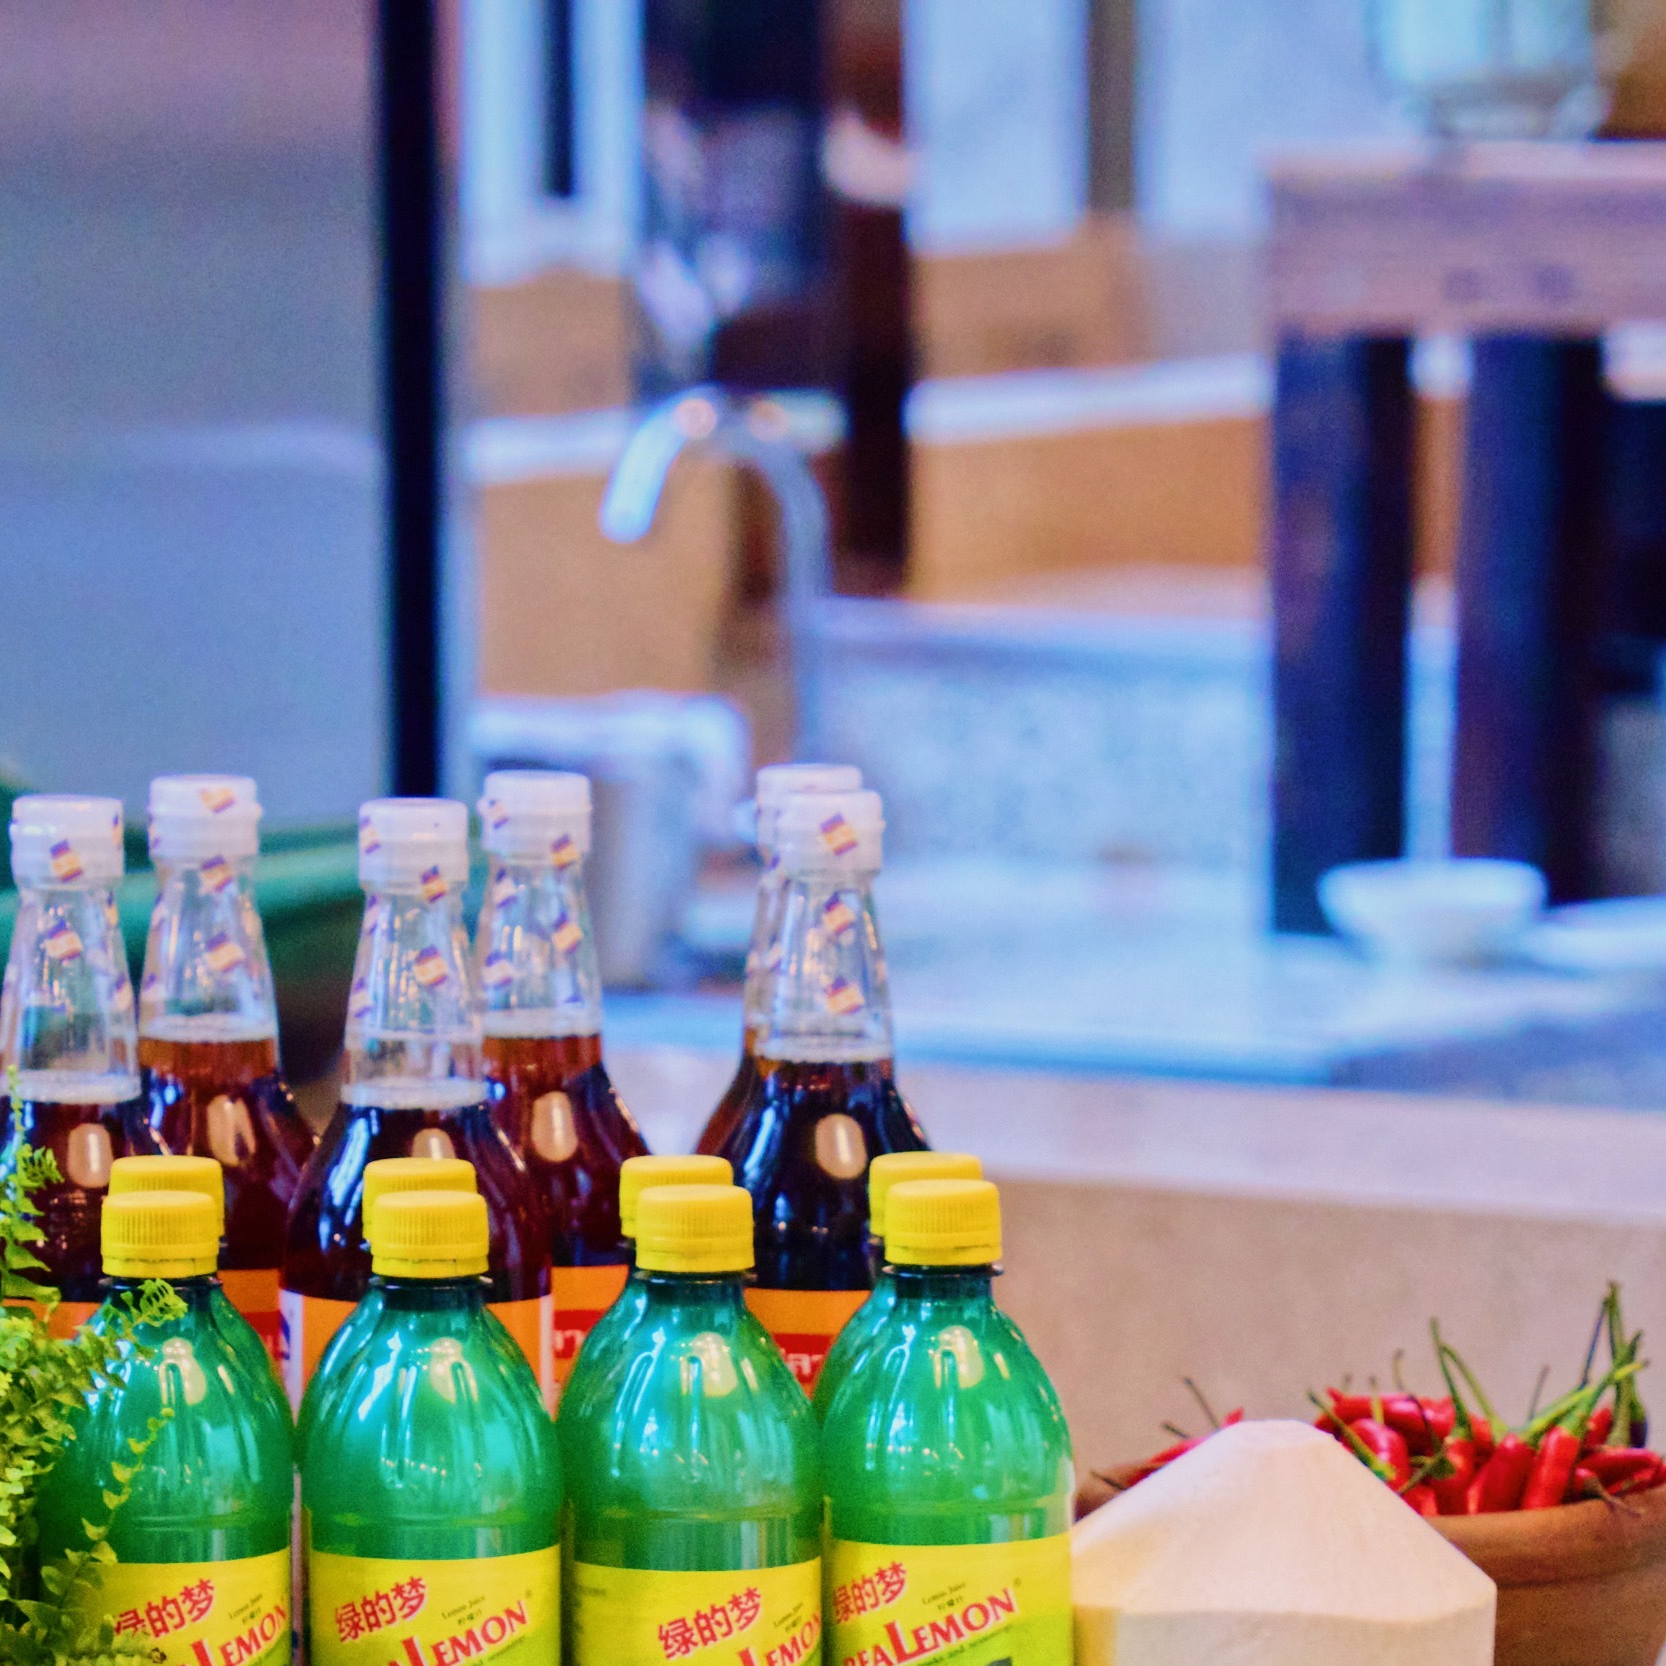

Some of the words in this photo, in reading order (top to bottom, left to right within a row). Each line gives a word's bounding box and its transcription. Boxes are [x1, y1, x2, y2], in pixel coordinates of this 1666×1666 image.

[335, 1576, 427, 1643] 绿的梦
[658, 1587, 762, 1660] 绿的梦
